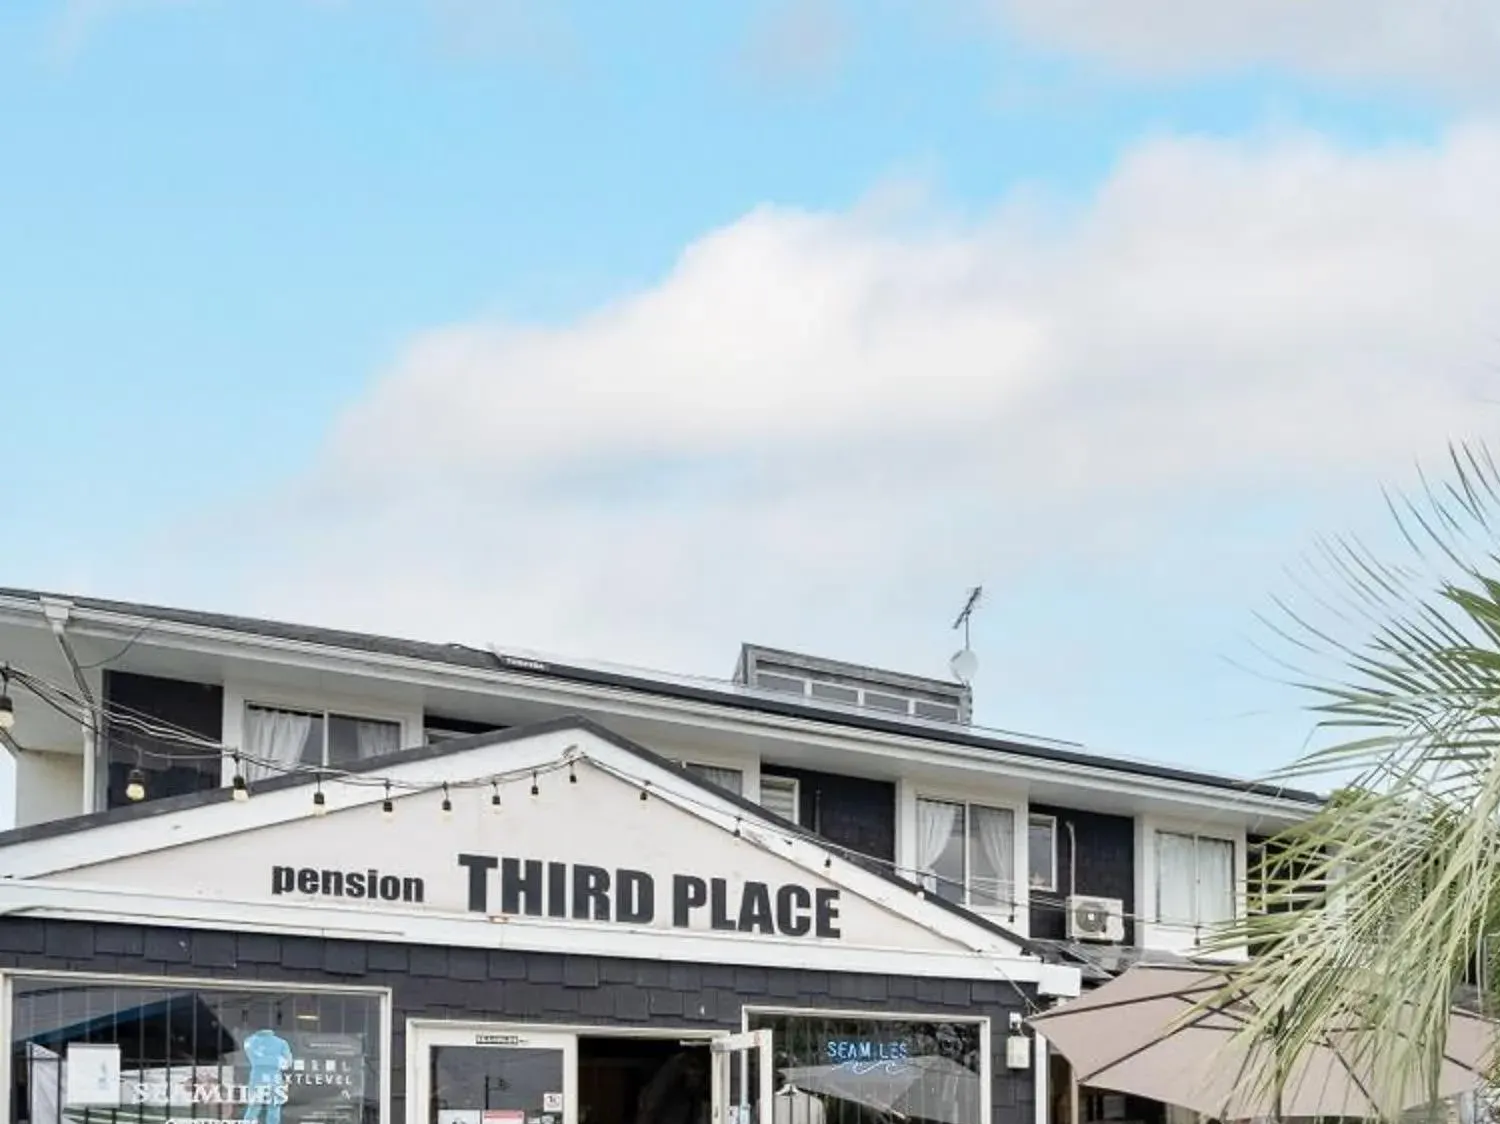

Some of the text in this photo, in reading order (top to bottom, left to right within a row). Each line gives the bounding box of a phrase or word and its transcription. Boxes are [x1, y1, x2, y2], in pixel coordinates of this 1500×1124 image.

[272, 854, 841, 939] pension THIRD PLACE
[827, 1041, 907, 1059] SEAMLES
